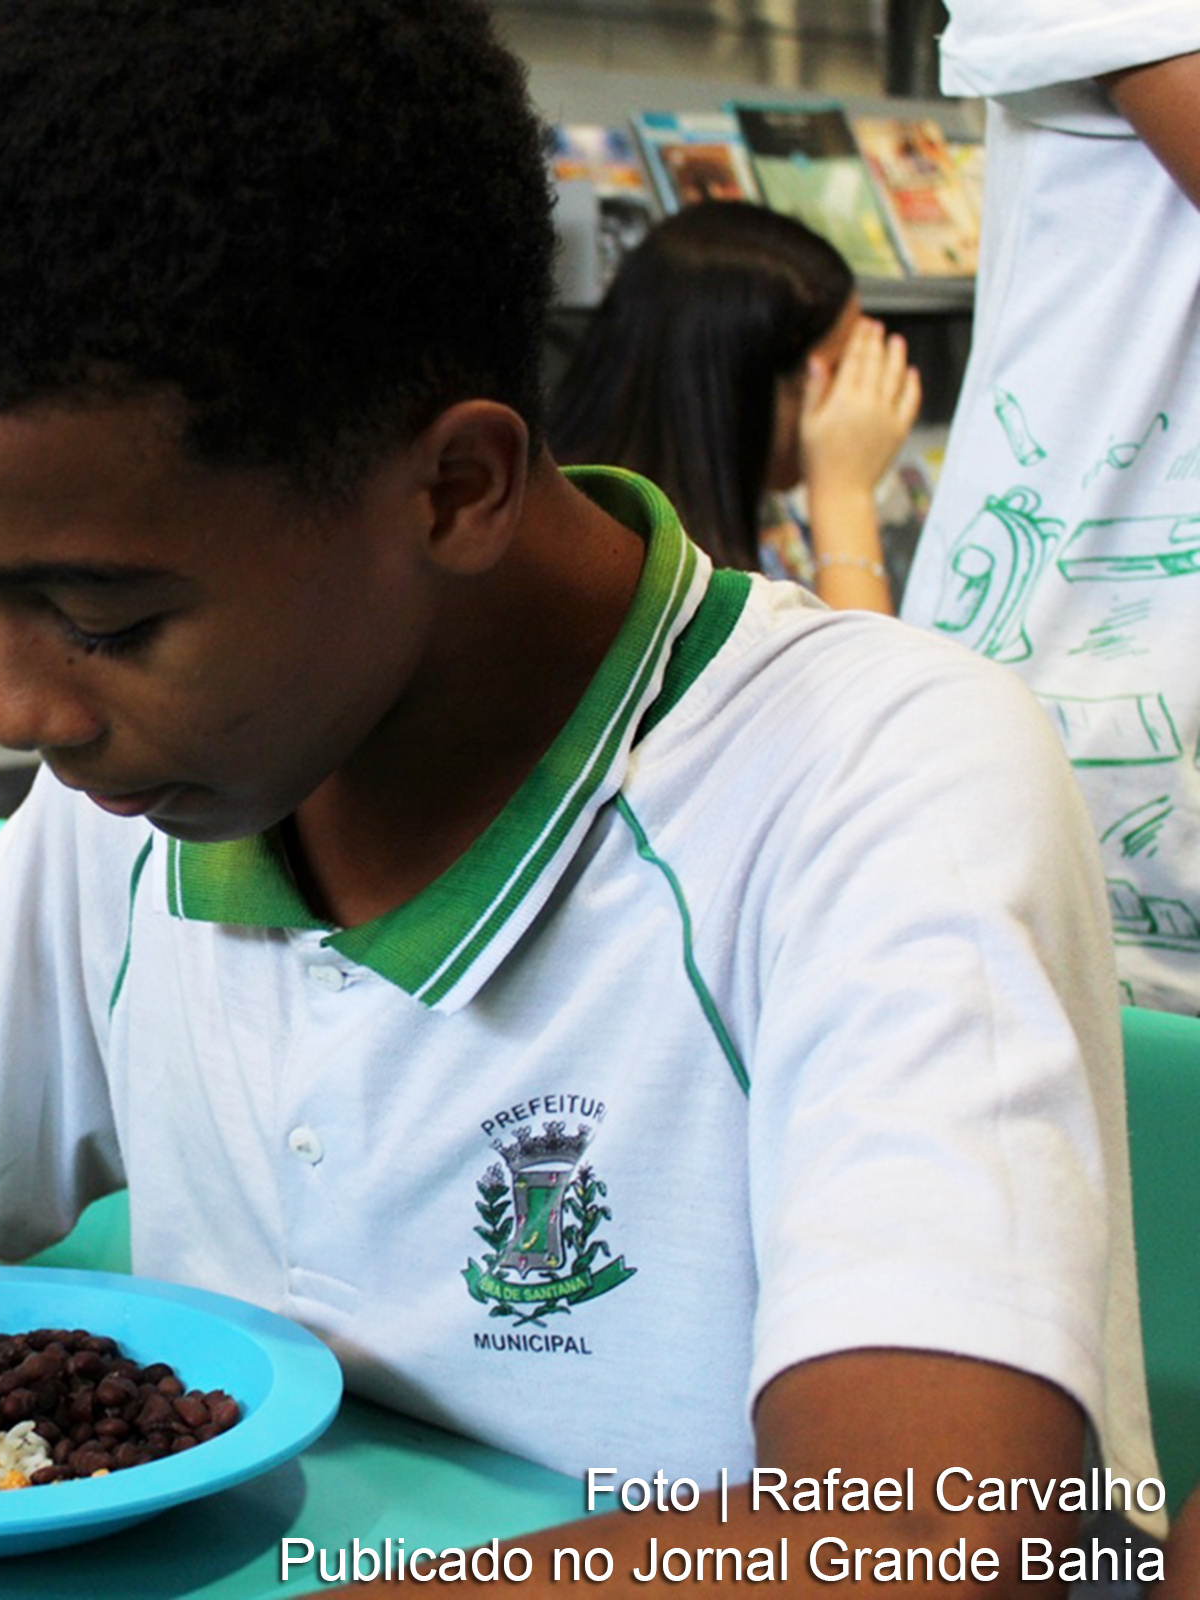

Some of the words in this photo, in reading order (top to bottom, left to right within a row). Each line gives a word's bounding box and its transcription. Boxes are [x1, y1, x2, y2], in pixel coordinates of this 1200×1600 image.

[480, 1094, 608, 1137] PREFEITUR
[503, 1286, 521, 1301] DE
[522, 1276, 588, 1301] SANTANA
[473, 1332, 593, 1356] MUNICIPAL
